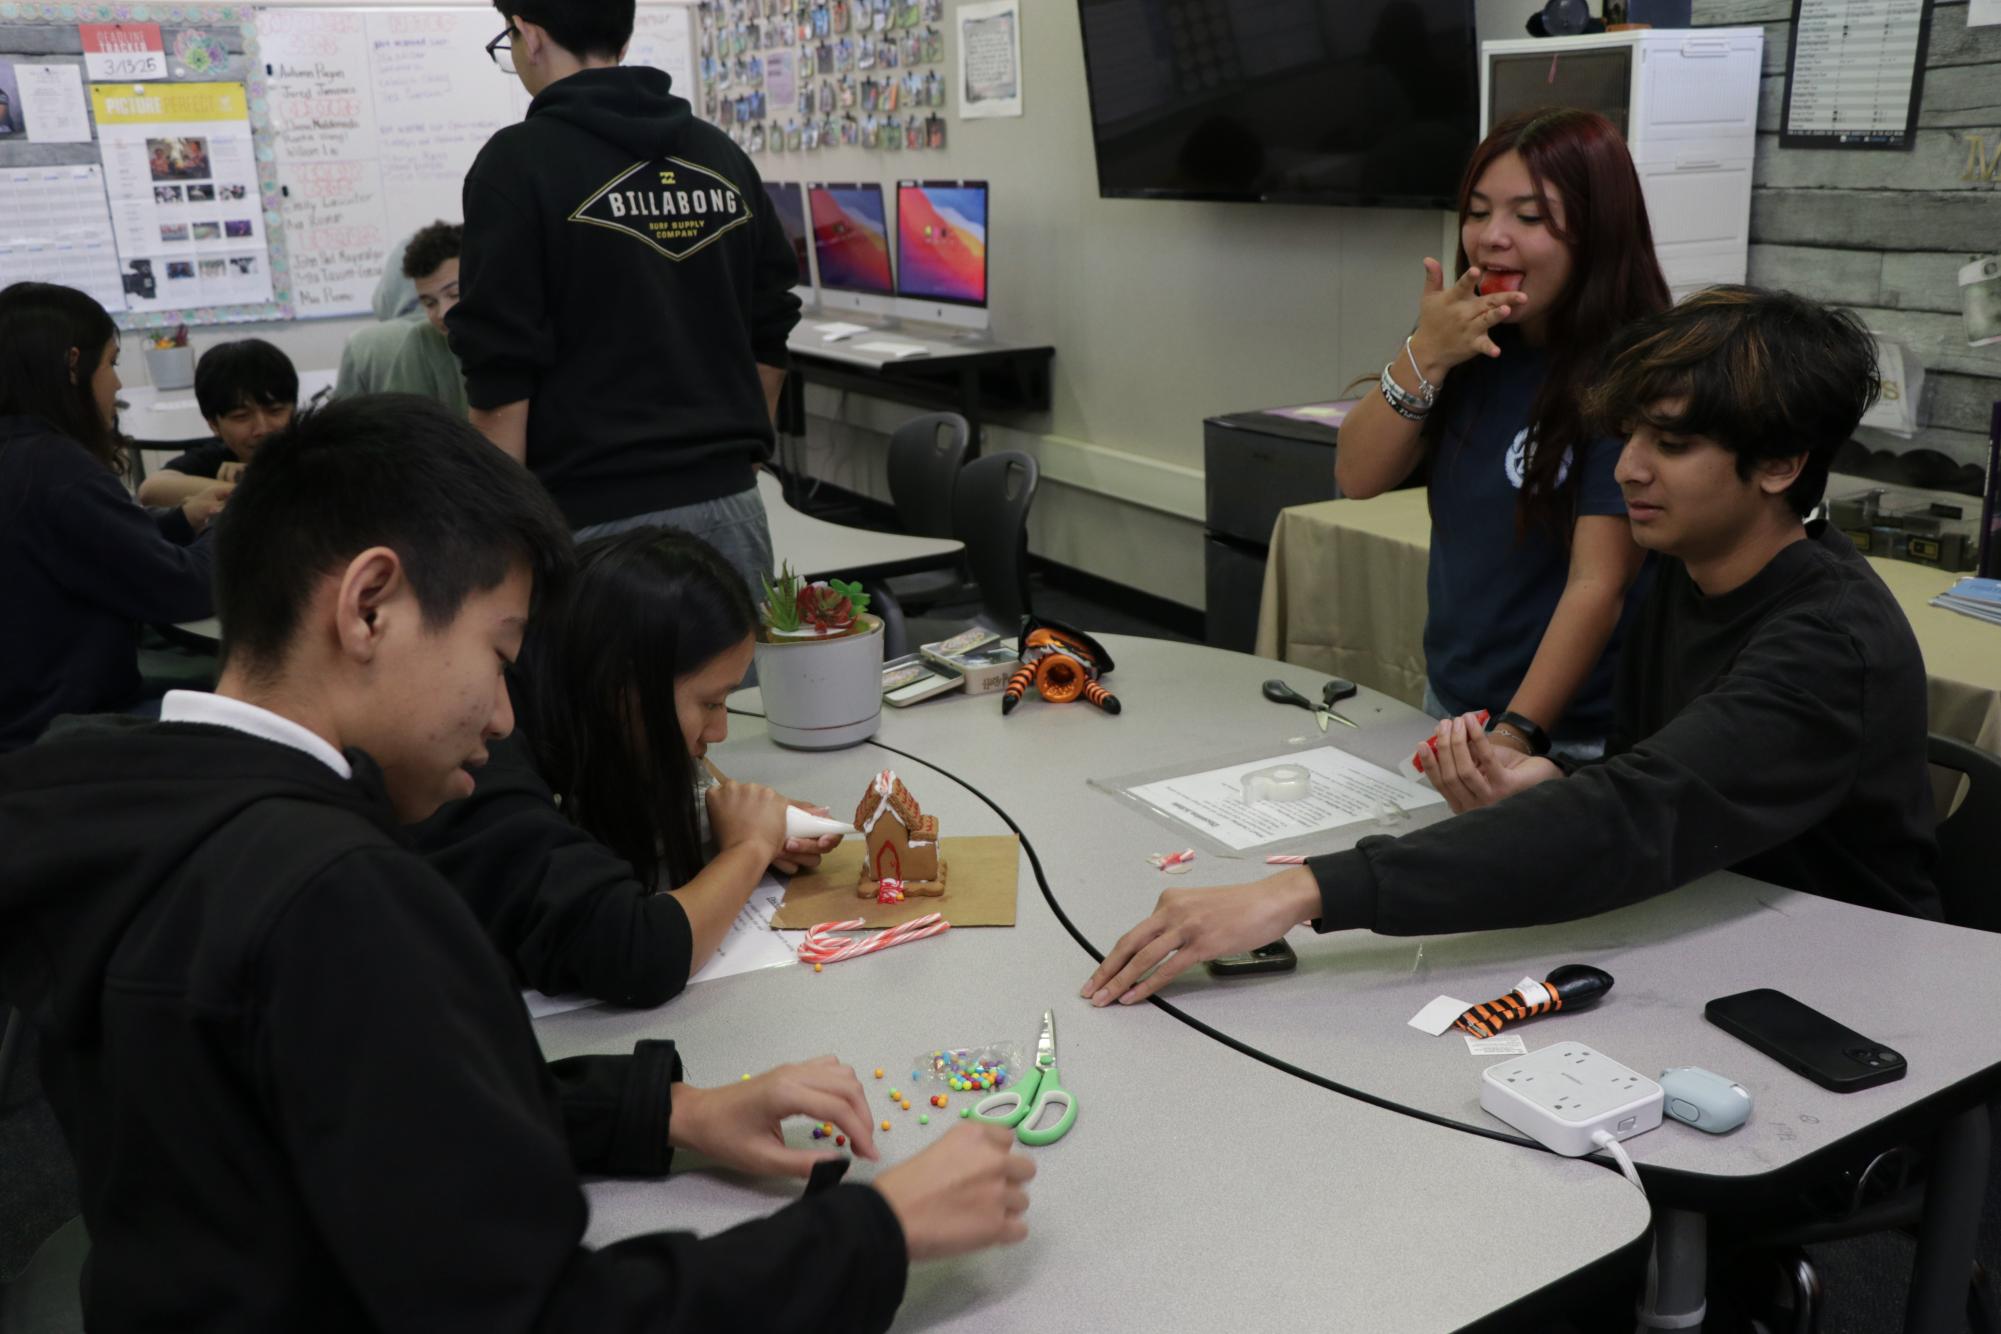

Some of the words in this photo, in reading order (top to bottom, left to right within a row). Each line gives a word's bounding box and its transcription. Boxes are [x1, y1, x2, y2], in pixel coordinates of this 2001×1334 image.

[96, 31, 145, 43] DEADLINE
[99, 41, 149, 53] TRACKER
[105, 96, 161, 115] PICTURE
[163, 95, 215, 113] PERFECT
[608, 189, 737, 217] BILLABONG
[649, 222, 669, 230] SURF
[672, 220, 705, 229] SUPPLY
[656, 230, 698, 239] COMPANY
